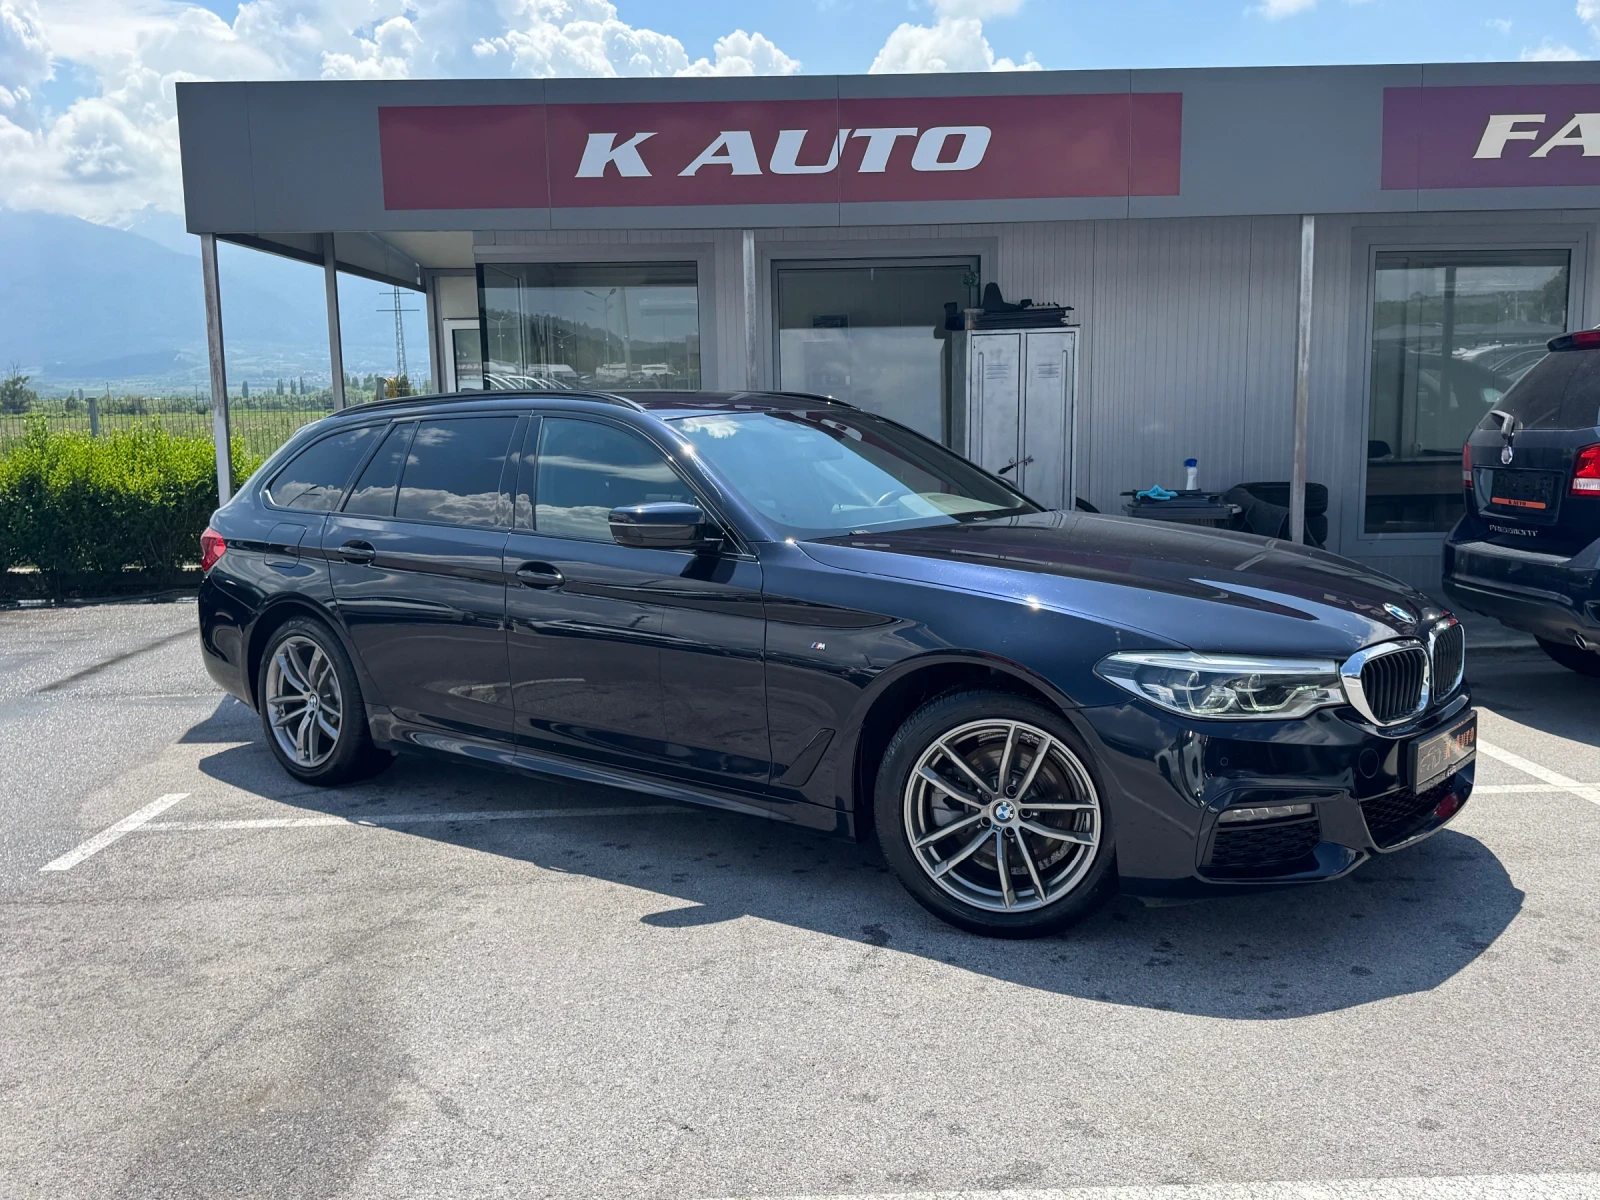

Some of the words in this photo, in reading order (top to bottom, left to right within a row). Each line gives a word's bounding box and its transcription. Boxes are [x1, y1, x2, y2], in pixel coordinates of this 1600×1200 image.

[575, 132, 657, 178] K
[677, 126, 992, 177] AUTO
[1472, 113, 1600, 159] FA
